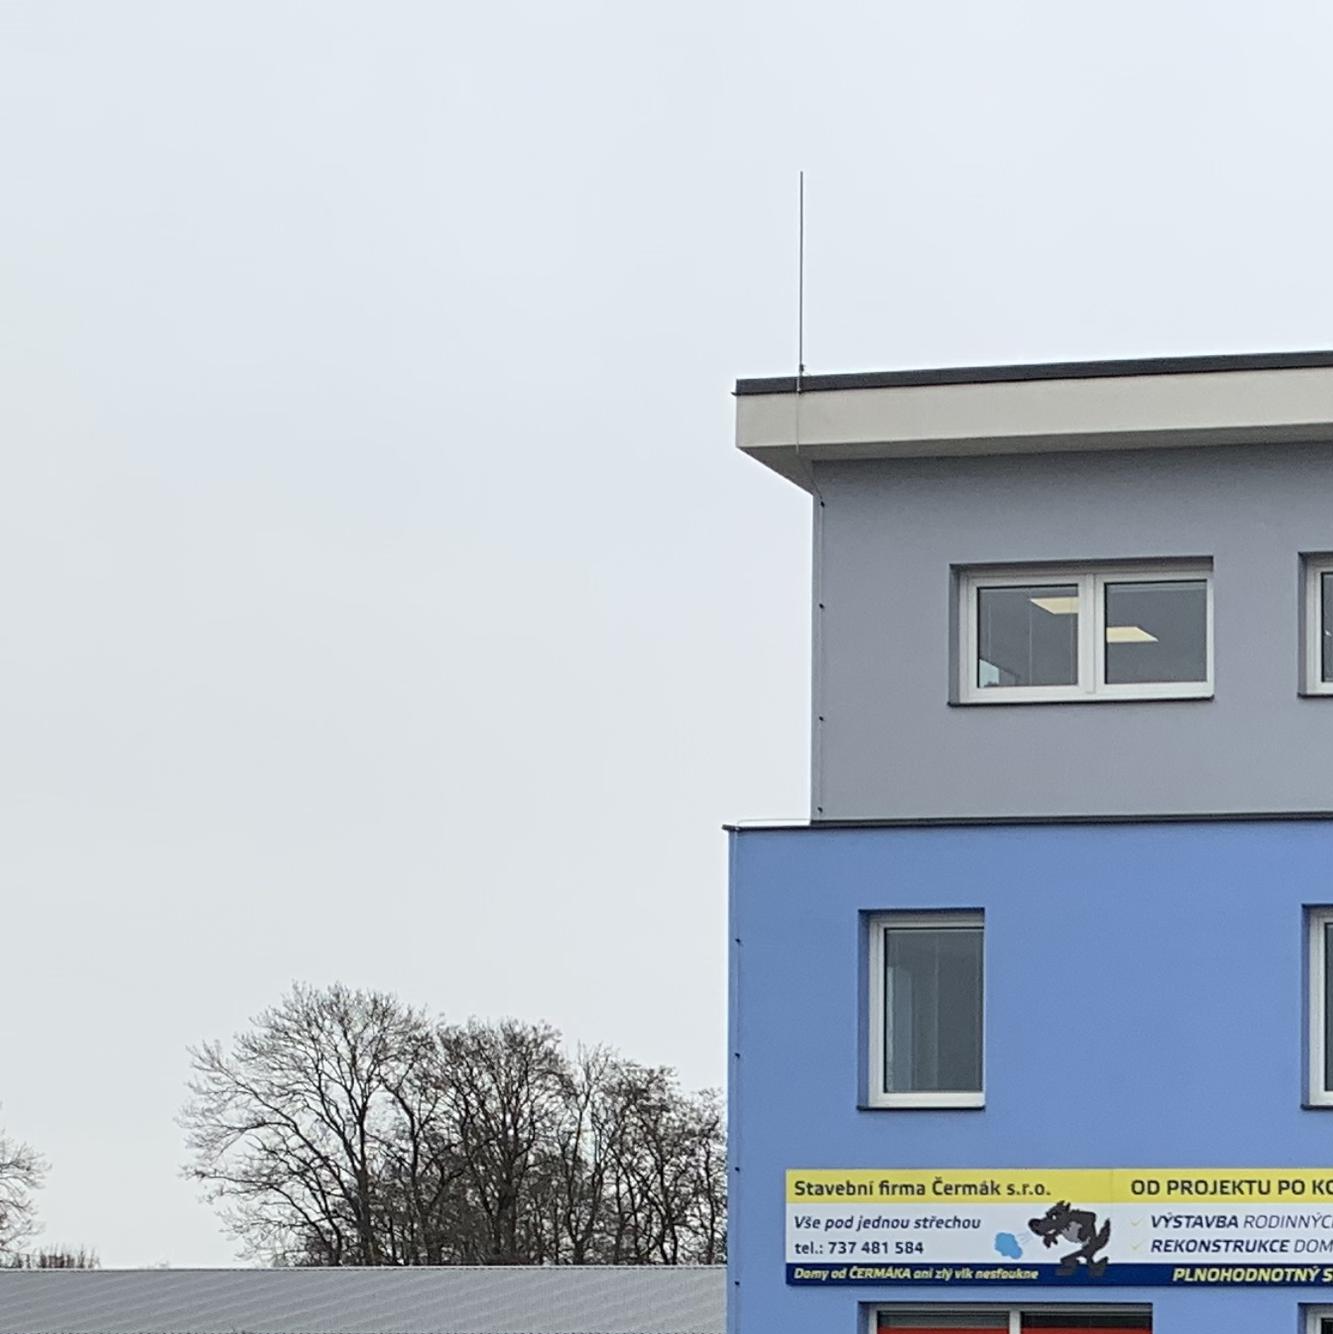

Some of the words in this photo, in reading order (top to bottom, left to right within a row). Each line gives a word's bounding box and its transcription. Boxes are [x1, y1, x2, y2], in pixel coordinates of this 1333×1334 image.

[794, 1179, 873, 1197] Stavební
[878, 1180, 926, 1197] firma
[932, 1177, 1000, 1197] Čermák
[1006, 1183, 1051, 1197] s.r.o.
[1131, 1179, 1160, 1196] OD
[1167, 1179, 1271, 1196] PROJEKTU
[1278, 1179, 1306, 1195] PO
[794, 1215, 821, 1229] Vše
[824, 1216, 853, 1232] pod
[855, 1216, 910, 1232] jednou
[913, 1215, 981, 1229] střechou
[1151, 1211, 1239, 1229] VÝSTAVBA
[794, 1241, 823, 1254] tel.:
[828, 1241, 857, 1254] 737
[861, 1241, 889, 1254] 481
[895, 1241, 924, 1254] 584
[1151, 1238, 1289, 1253] REKONSTRUKCE
[793, 1268, 828, 1281] Domy
[850, 1265, 912, 1279] ČERMÁKA
[1172, 1265, 1320, 1282] PLNOHODNOTNÝ
